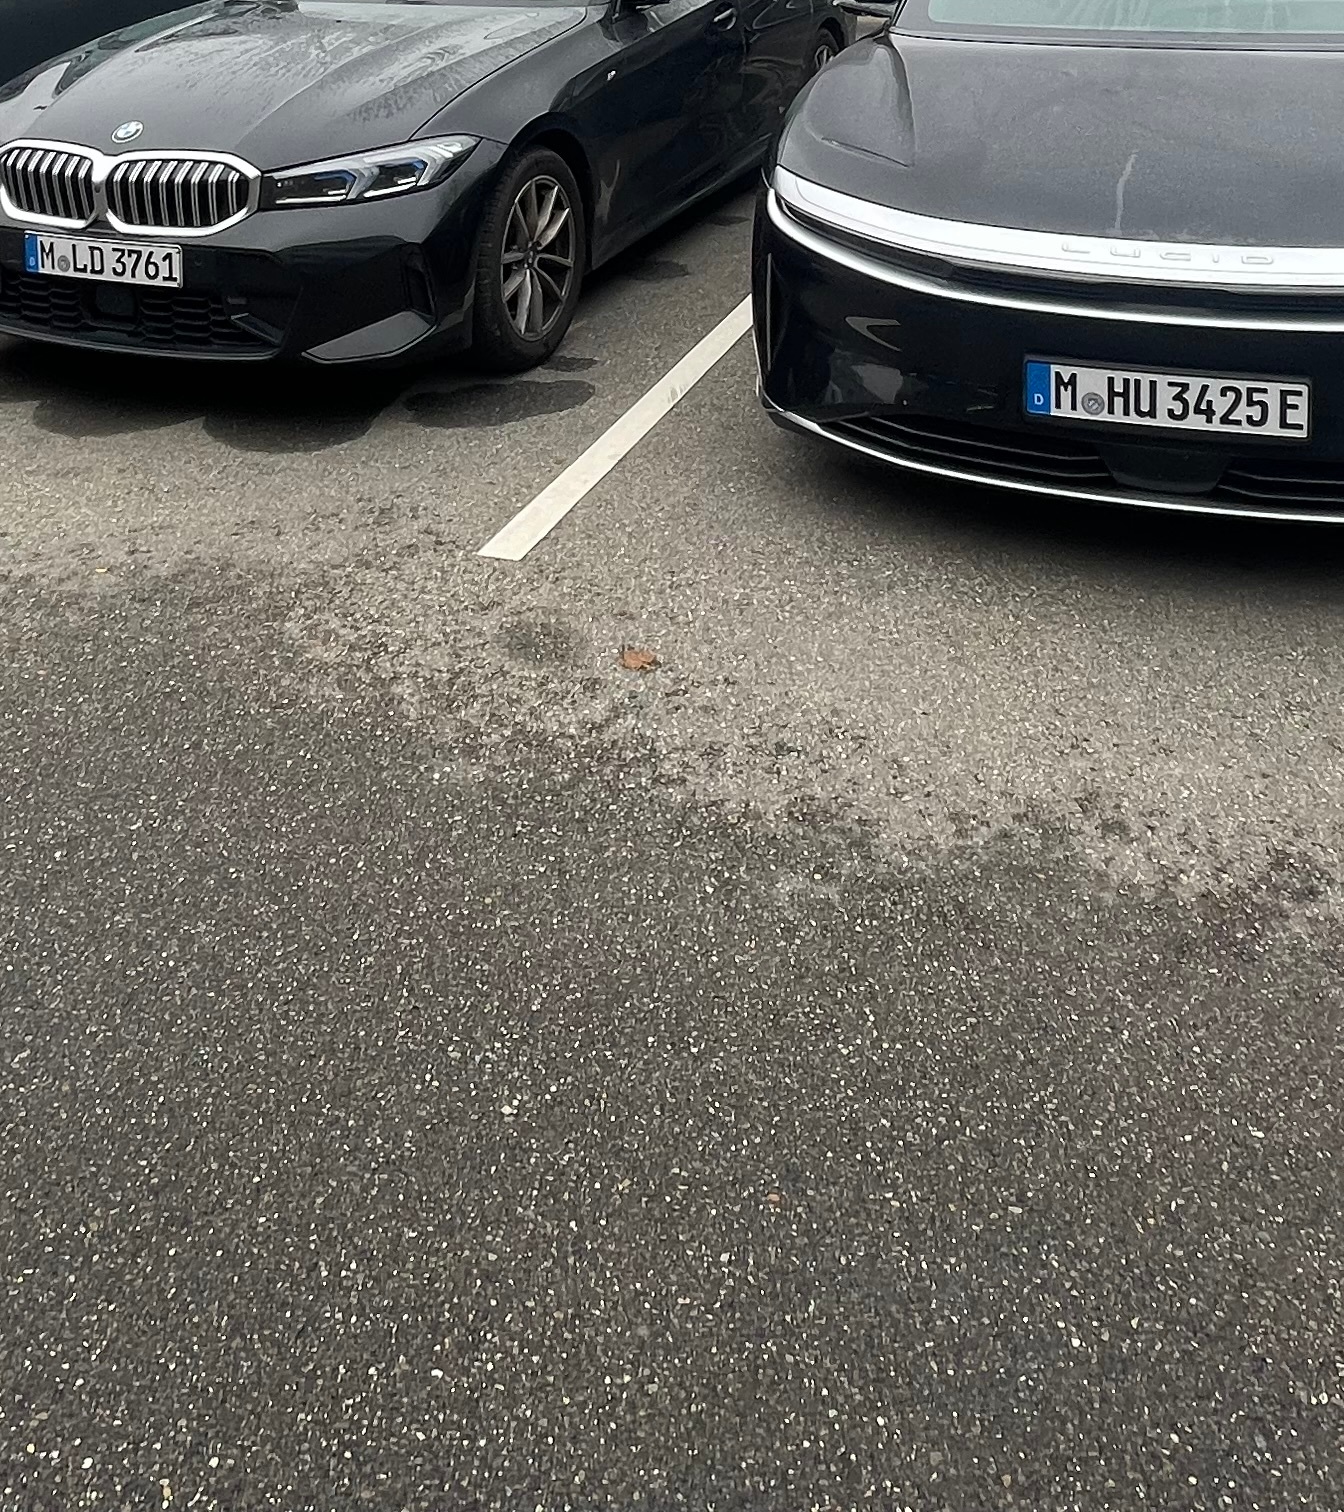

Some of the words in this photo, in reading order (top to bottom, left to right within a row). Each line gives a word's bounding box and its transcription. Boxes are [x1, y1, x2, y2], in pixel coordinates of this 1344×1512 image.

[39, 240, 55, 270] M
[72, 244, 105, 275] LD
[111, 247, 178, 282] 3761
[1061, 241, 1274, 265] LUCID
[1034, 393, 1044, 405] D
[1054, 370, 1078, 412] M
[1106, 375, 1157, 420] HU
